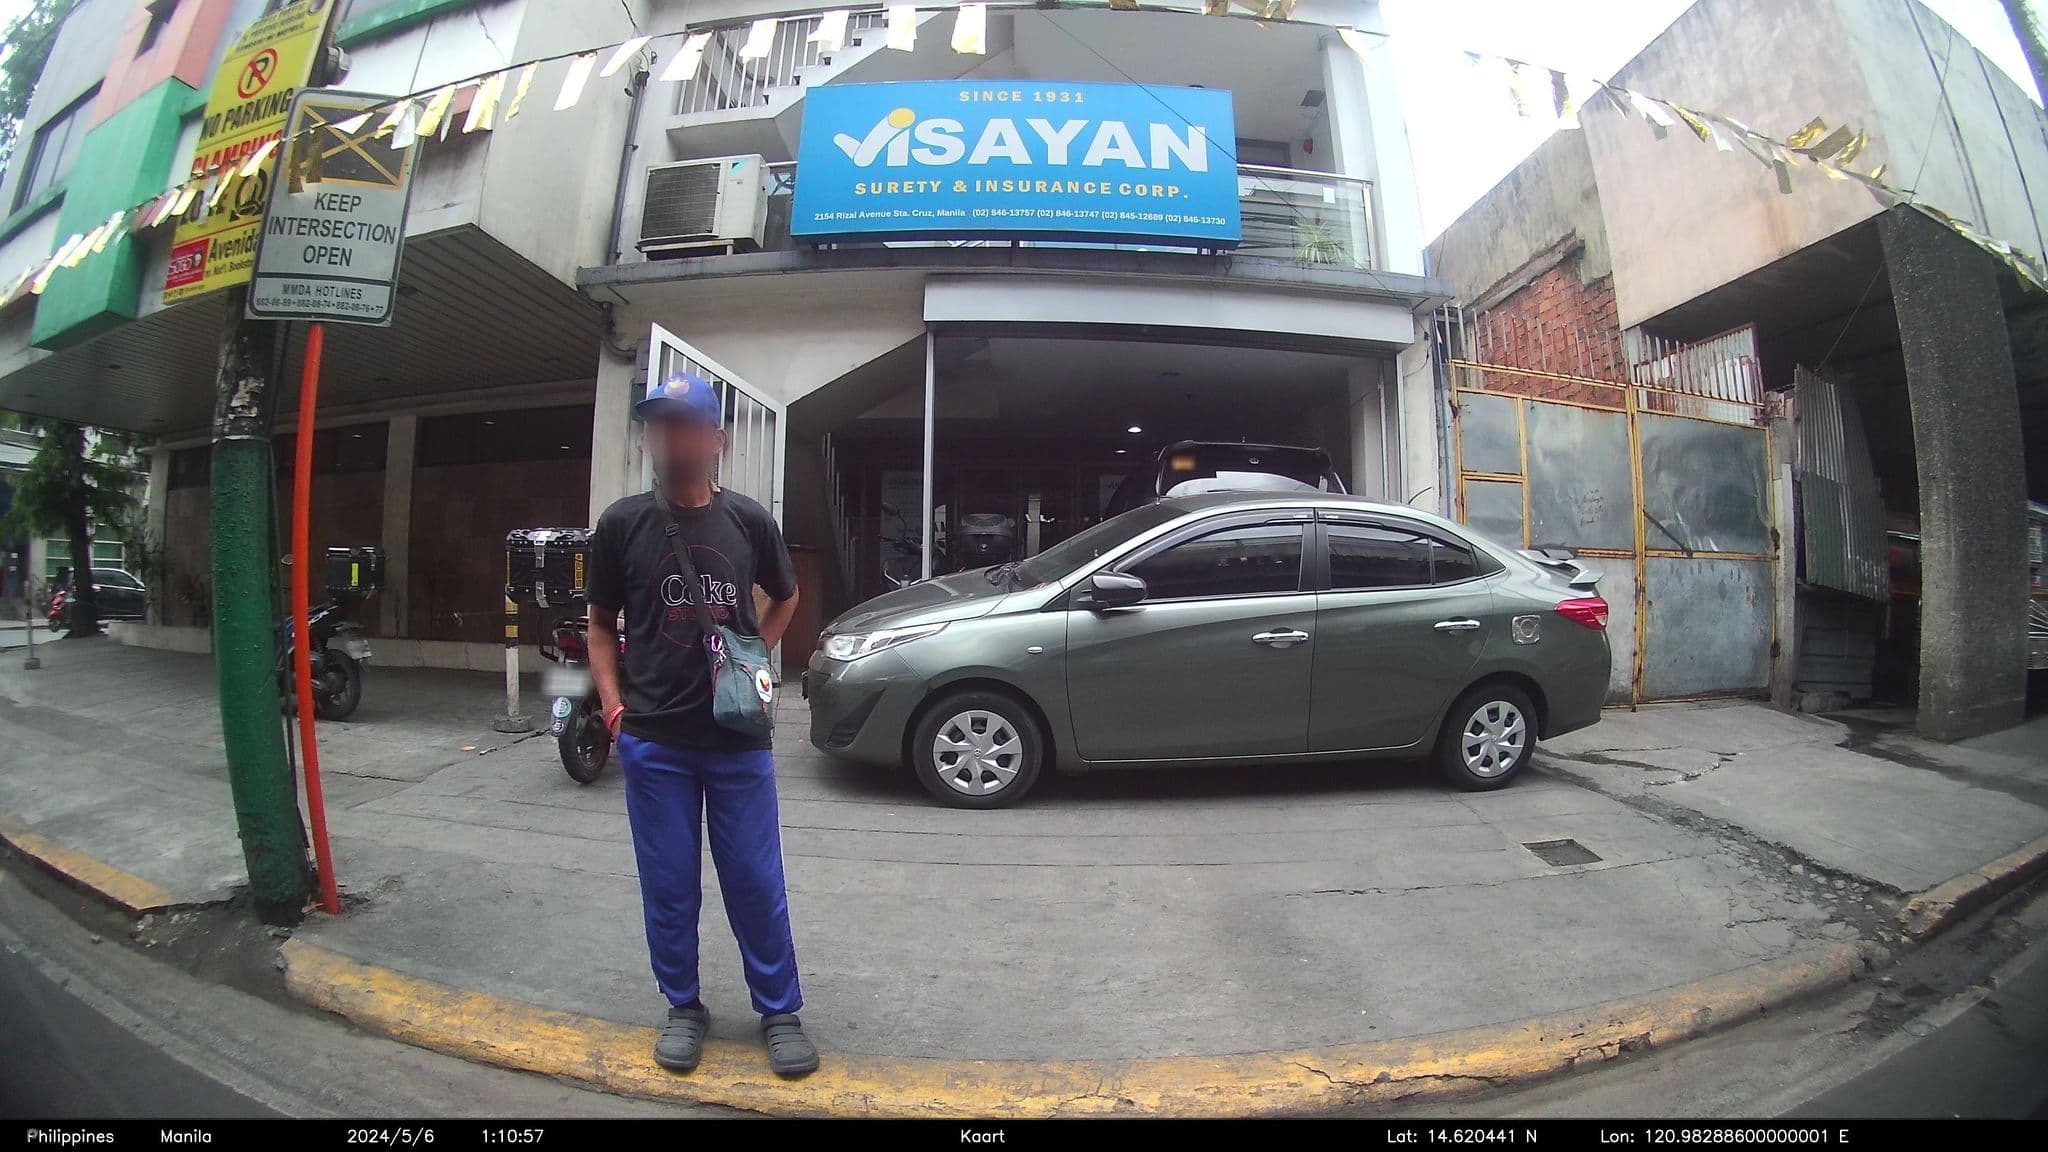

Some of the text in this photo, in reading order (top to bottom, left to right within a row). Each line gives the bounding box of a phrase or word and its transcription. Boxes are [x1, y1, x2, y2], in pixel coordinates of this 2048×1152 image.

[959, 91, 1084, 104] SINCE 1931
[222, 88, 294, 133] PARKING
[854, 180, 1189, 199] SURETY & INSURANCE CORP.
[314, 192, 361, 213] KEEP
[836, 211, 857, 220] Rizal
[859, 210, 891, 219] Avenue
[893, 209, 910, 218] Sta.
[911, 208, 935, 218] Cruz,
[937, 208, 966, 217] Manila
[972, 208, 989, 218] (02)
[1037, 208, 1054, 218] (02)
[1101, 211, 1118, 220] (02)
[1165, 213, 1181, 223] (02)
[268, 216, 396, 245] INTERSECTION
[303, 245, 353, 266] OPEN
[282, 283, 362, 300] MMDA HOTLINES
